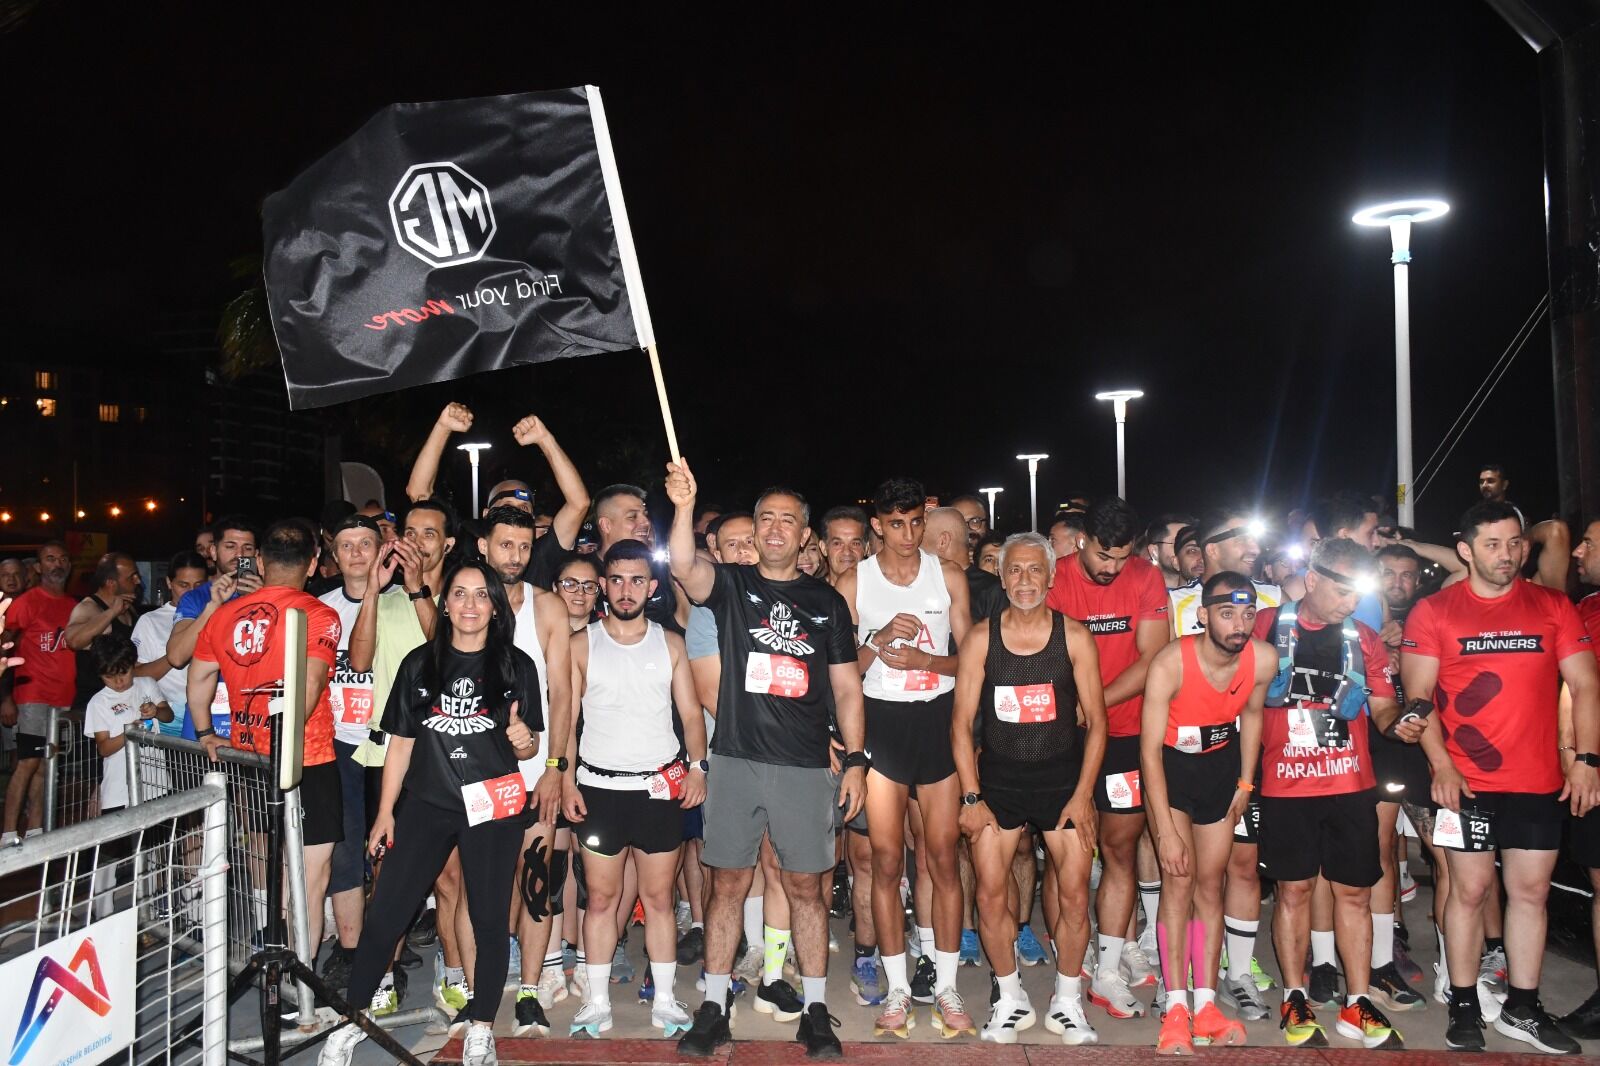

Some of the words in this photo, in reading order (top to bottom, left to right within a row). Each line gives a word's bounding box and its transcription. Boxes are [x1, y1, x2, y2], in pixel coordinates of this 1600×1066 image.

[1466, 638, 1537, 651] RUNNERS
[776, 666, 805, 680] 688
[453, 678, 474, 697] MG
[350, 697, 370, 709] 710
[440, 693, 482, 717] GECE
[1022, 694, 1050, 707] 649
[1326, 718, 1336, 730] 7
[1210, 731, 1228, 741] 82
[450, 751, 467, 759] zone
[668, 765, 684, 780] 691
[495, 783, 521, 801] 722
[1469, 820, 1490, 835] 121
